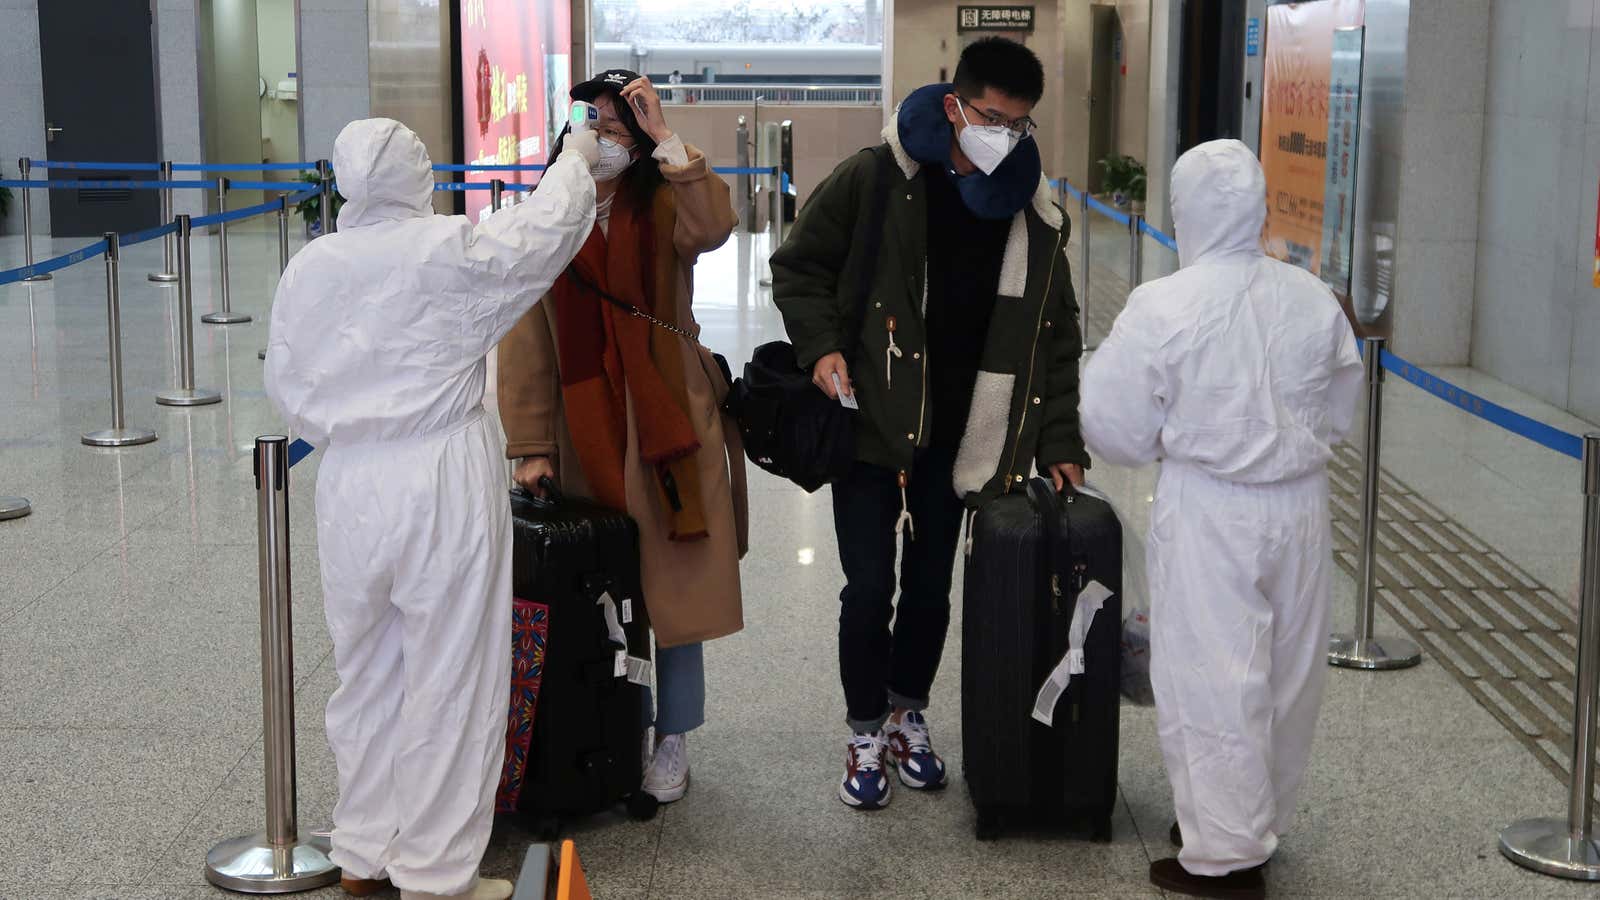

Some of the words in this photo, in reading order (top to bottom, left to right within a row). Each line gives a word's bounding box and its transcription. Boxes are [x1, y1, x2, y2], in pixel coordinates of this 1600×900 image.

[981, 9, 1031, 20] 无障碍电梯
